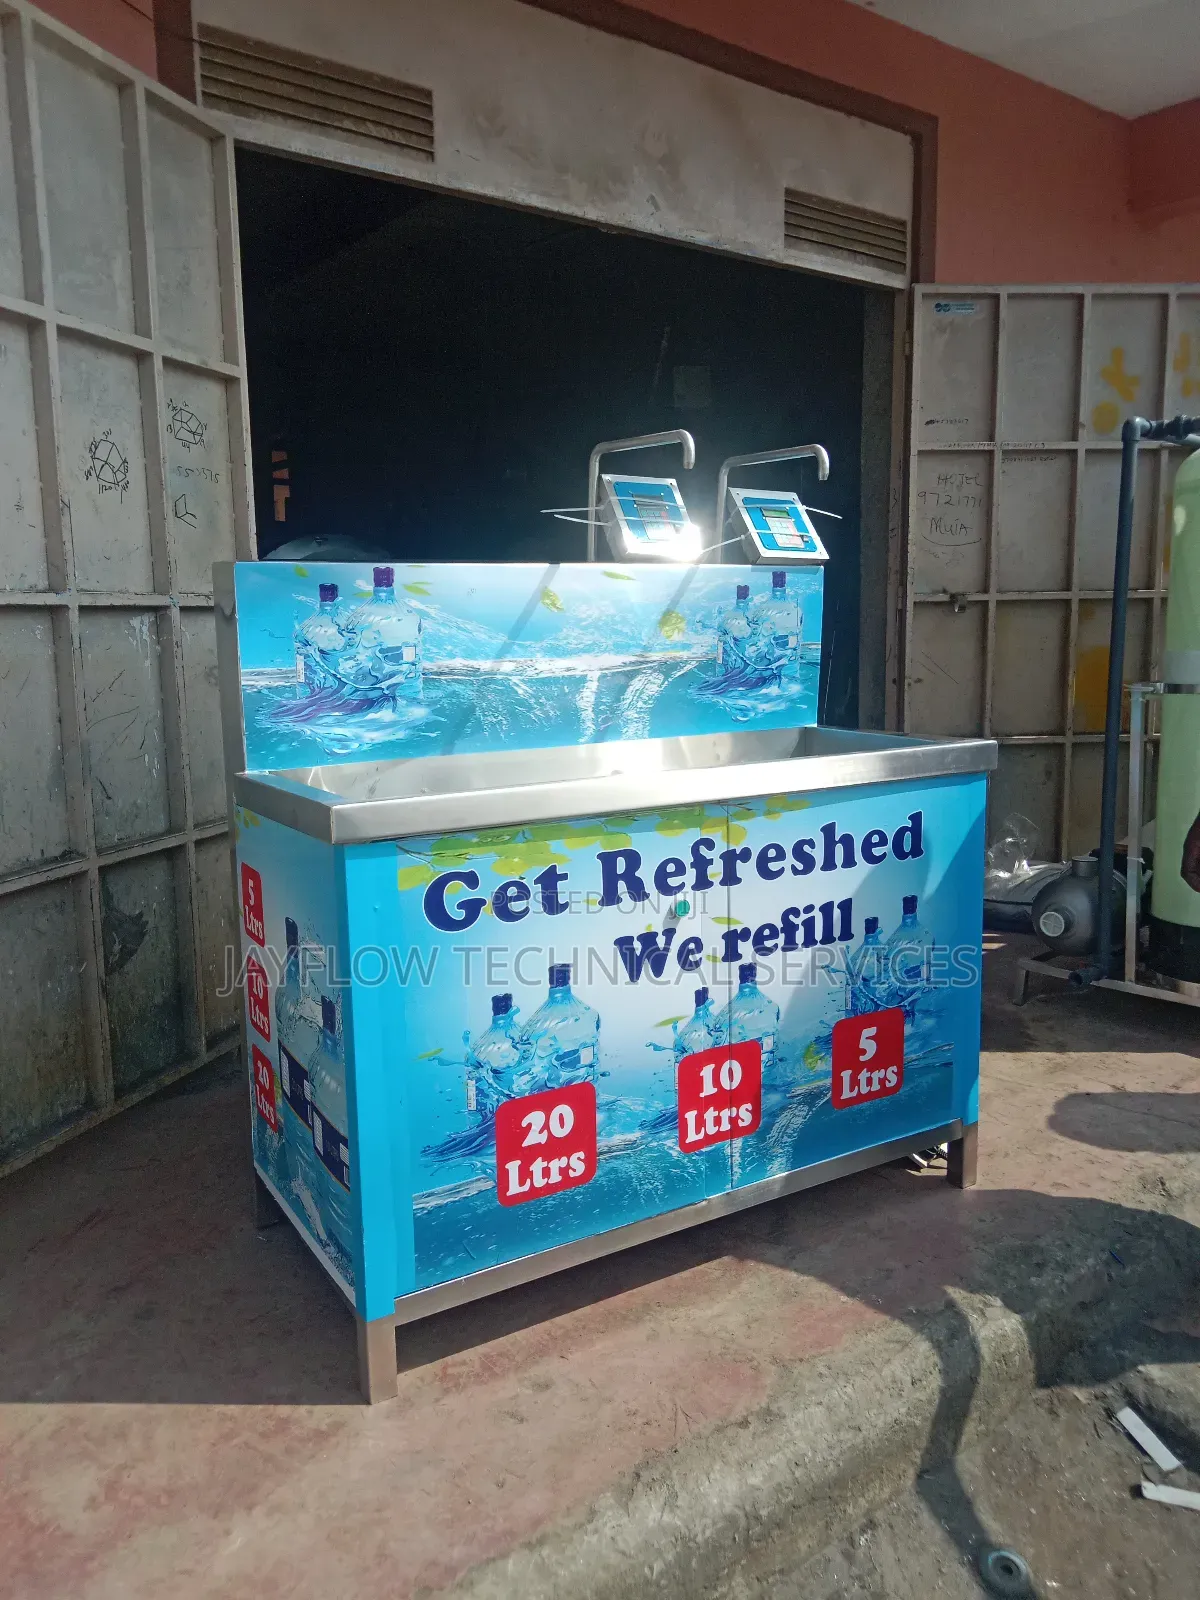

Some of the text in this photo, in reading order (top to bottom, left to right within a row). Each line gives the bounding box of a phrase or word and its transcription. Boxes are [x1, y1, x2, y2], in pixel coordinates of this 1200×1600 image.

[424, 810, 925, 932] Get Refreshed
[248, 878, 256, 906] 5
[245, 905, 263, 940] Ltrs
[613, 898, 855, 983] We refill
[252, 972, 264, 999] 10
[250, 997, 269, 1035] Ltrs
[857, 1026, 878, 1062] 5
[257, 1060, 270, 1090] 20
[699, 1059, 743, 1097] 10
[840, 1058, 898, 1101] Ltrs
[255, 1083, 275, 1125] Ltrs
[685, 1100, 753, 1144] Ltrs
[521, 1103, 575, 1148] 20
[505, 1147, 586, 1197] Ltrs
